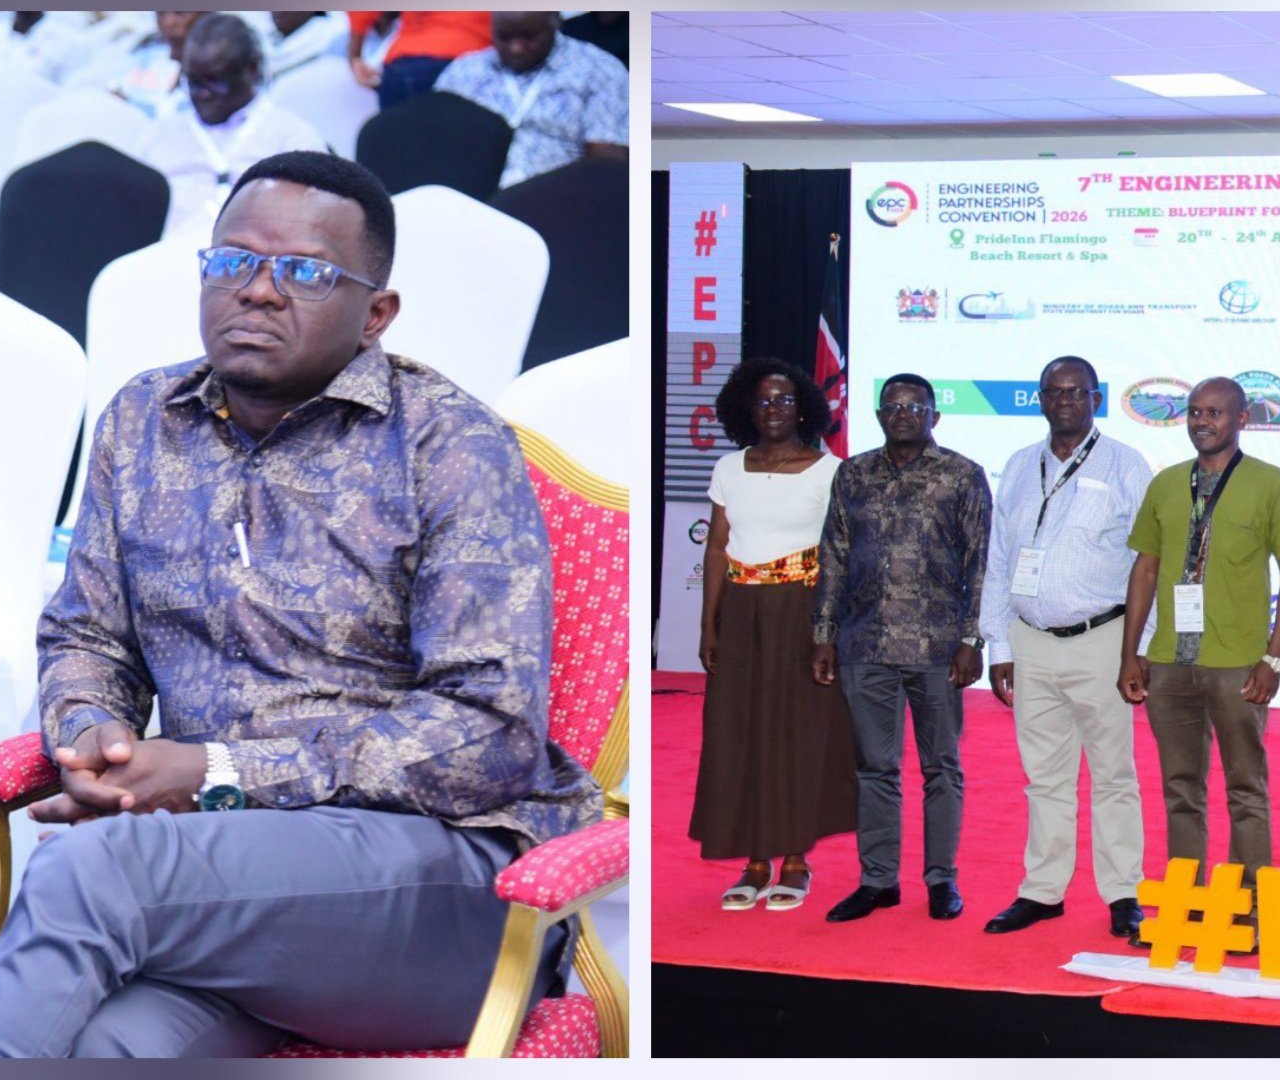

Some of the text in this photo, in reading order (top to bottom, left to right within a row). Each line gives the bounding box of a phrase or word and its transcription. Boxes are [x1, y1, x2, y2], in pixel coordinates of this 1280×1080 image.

[938, 182, 1040, 196] ENGINEERING
[1078, 173, 1113, 193] 7TH
[876, 197, 906, 213] epc
[938, 196, 1045, 210] PARTNERSHIPS
[938, 210, 1088, 224] CONVENTION 2026
[1105, 206, 1165, 218] THEME:
[1168, 206, 1258, 218] BLUEPRINT
[974, 232, 1108, 247] PrideInn Flamingo
[1176, 229, 1213, 244] 20TH
[969, 250, 1014, 262] Beach
[1017, 250, 1063, 262] Resort
[1079, 250, 1109, 264] Spa
